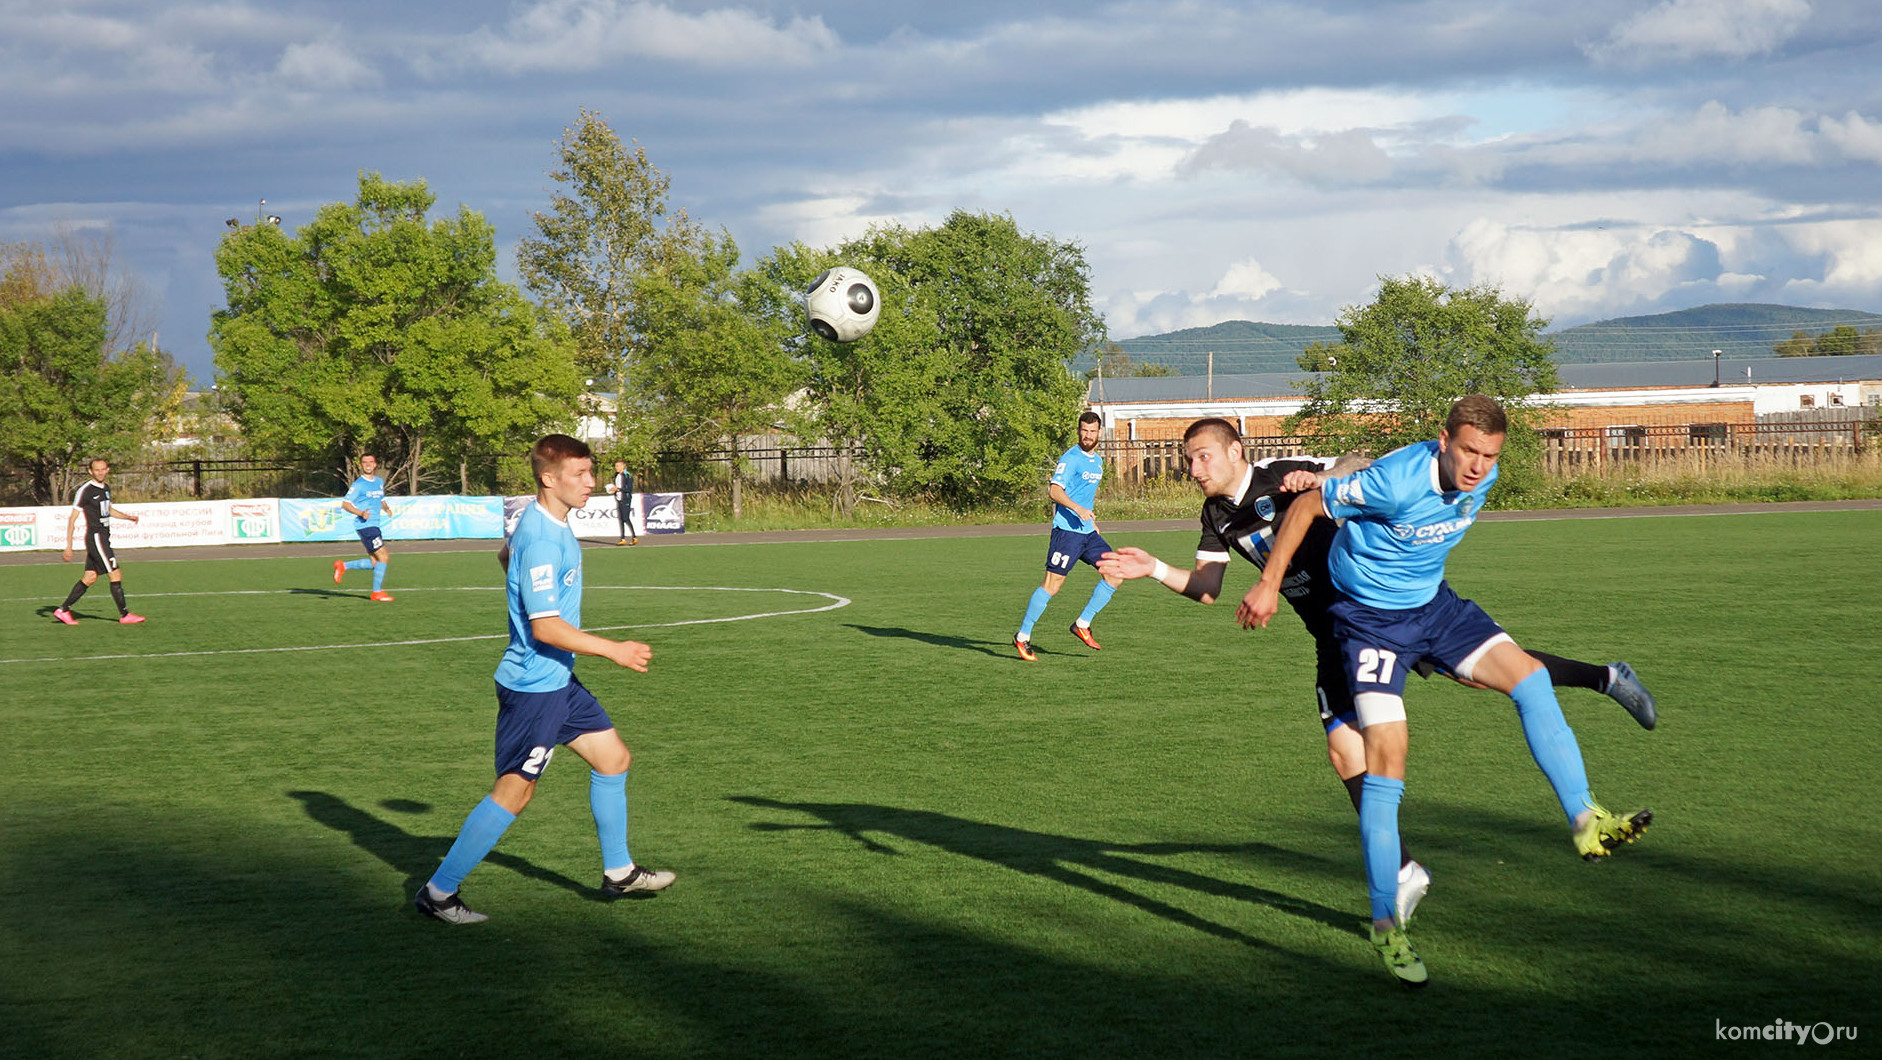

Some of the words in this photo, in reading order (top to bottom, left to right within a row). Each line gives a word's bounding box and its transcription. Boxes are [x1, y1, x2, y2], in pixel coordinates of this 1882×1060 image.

[1050, 551, 1070, 569] 61
[1356, 647, 1397, 685] 27
[521, 746, 554, 775] 21
